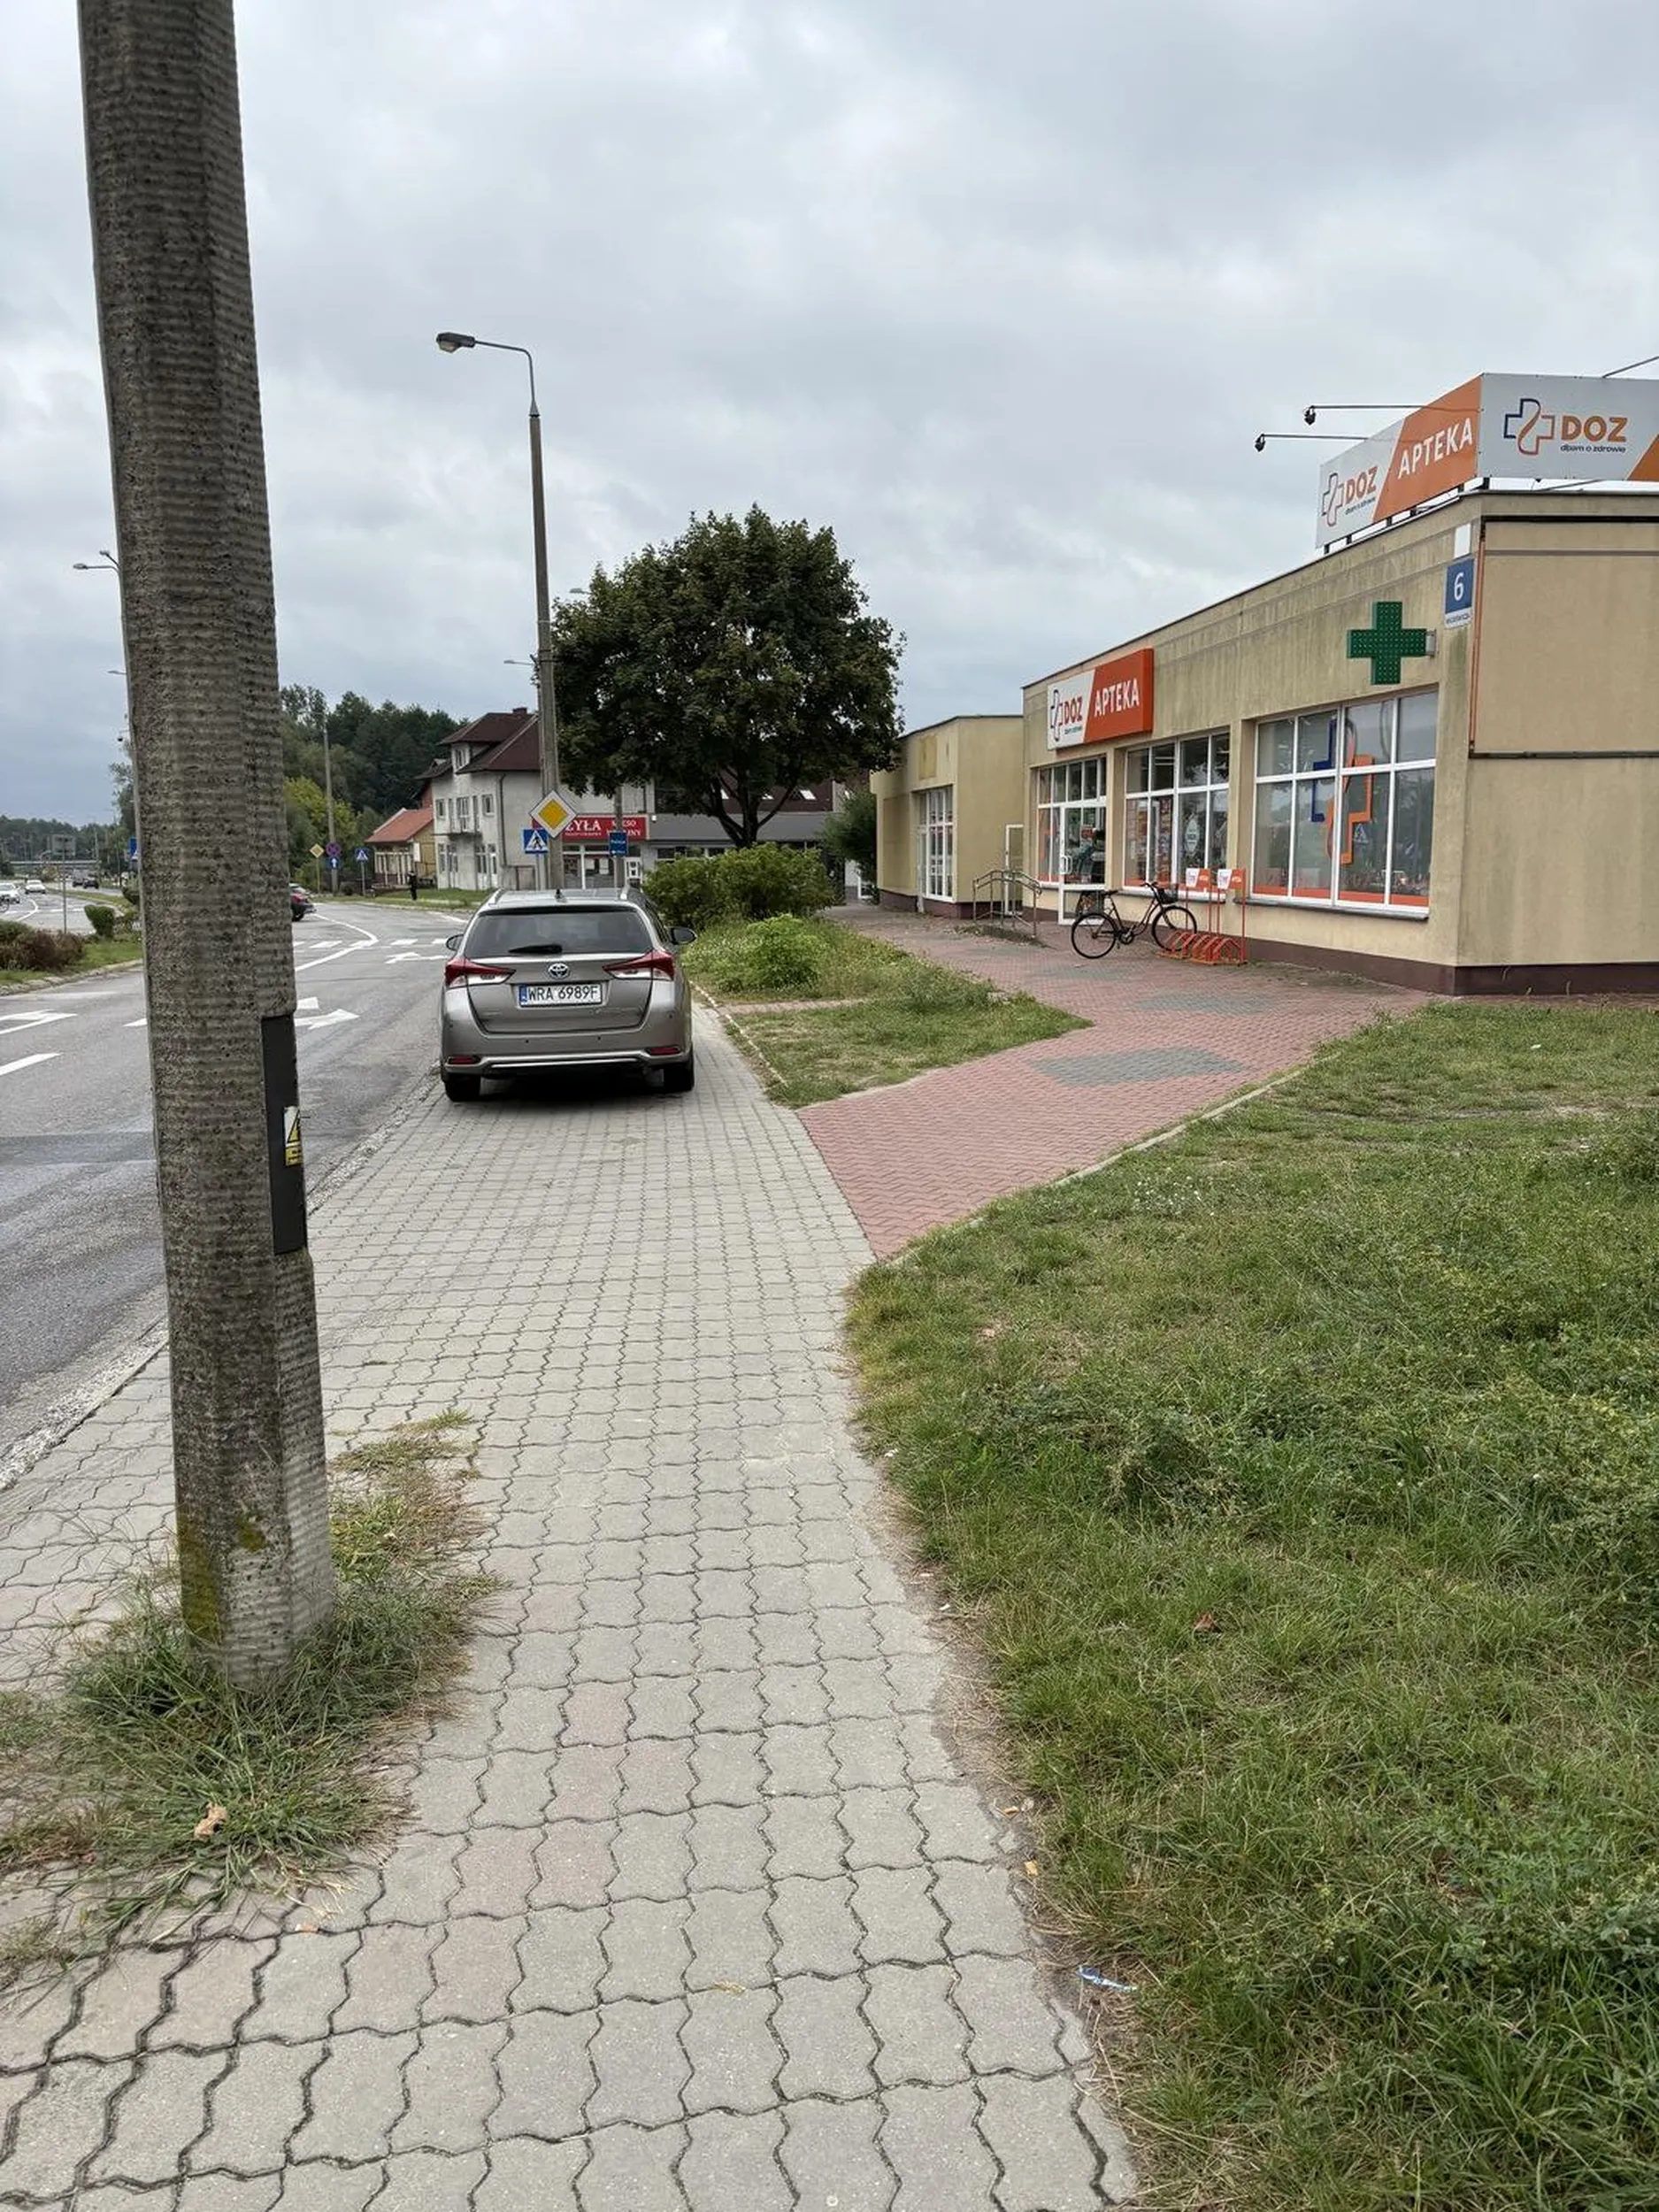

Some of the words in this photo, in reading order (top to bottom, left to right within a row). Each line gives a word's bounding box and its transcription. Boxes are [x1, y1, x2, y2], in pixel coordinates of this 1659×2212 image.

[1560, 415, 1628, 442] DOZ
[1398, 418, 1473, 480] APTEKA
[1345, 466, 1379, 504] DOZ
[1454, 572, 1464, 602] 6
[1064, 696, 1083, 725] DOZ
[1094, 678, 1140, 718] APTEKA
[528, 987, 553, 1001] WRA
[558, 985, 599, 1000] 6989F
